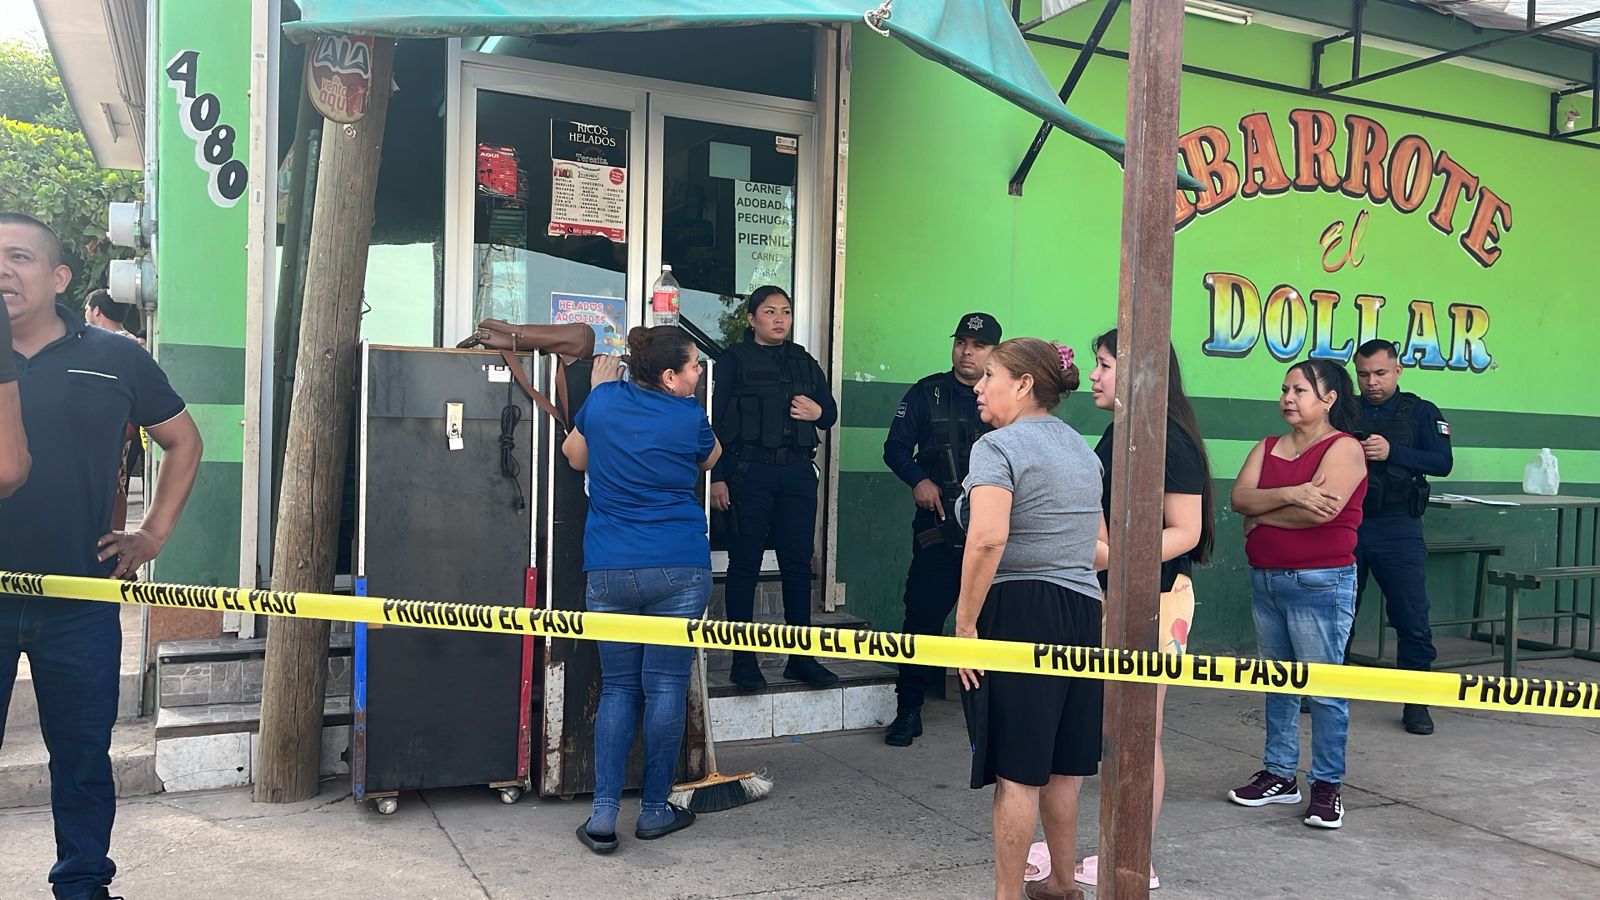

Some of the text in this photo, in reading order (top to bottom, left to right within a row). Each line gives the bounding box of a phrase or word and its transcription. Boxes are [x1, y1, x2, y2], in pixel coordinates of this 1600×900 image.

[166, 51, 249, 202] 4080
[569, 132, 616, 147] HELADOS
[577, 124, 609, 136] RICOS
[745, 183, 782, 195] CARNE
[738, 212, 790, 226] PECHUGA
[738, 232, 789, 248] PIERNIL
[1319, 209, 1370, 273] El
[751, 251, 782, 262] CARNE
[558, 300, 604, 312] HELADOS
[1202, 272, 1492, 373] DOLLAR
[1, 572, 44, 596] PASO
[120, 580, 297, 615] PROHIBIDO EL PASO
[383, 598, 585, 635] PROHIBIDO EL PASO
[686, 619, 916, 659] PROHIBIDO EL PASO
[1033, 643, 1309, 690] PROHIBIDO EL PASO
[1458, 674, 1600, 711] PROHIBI
